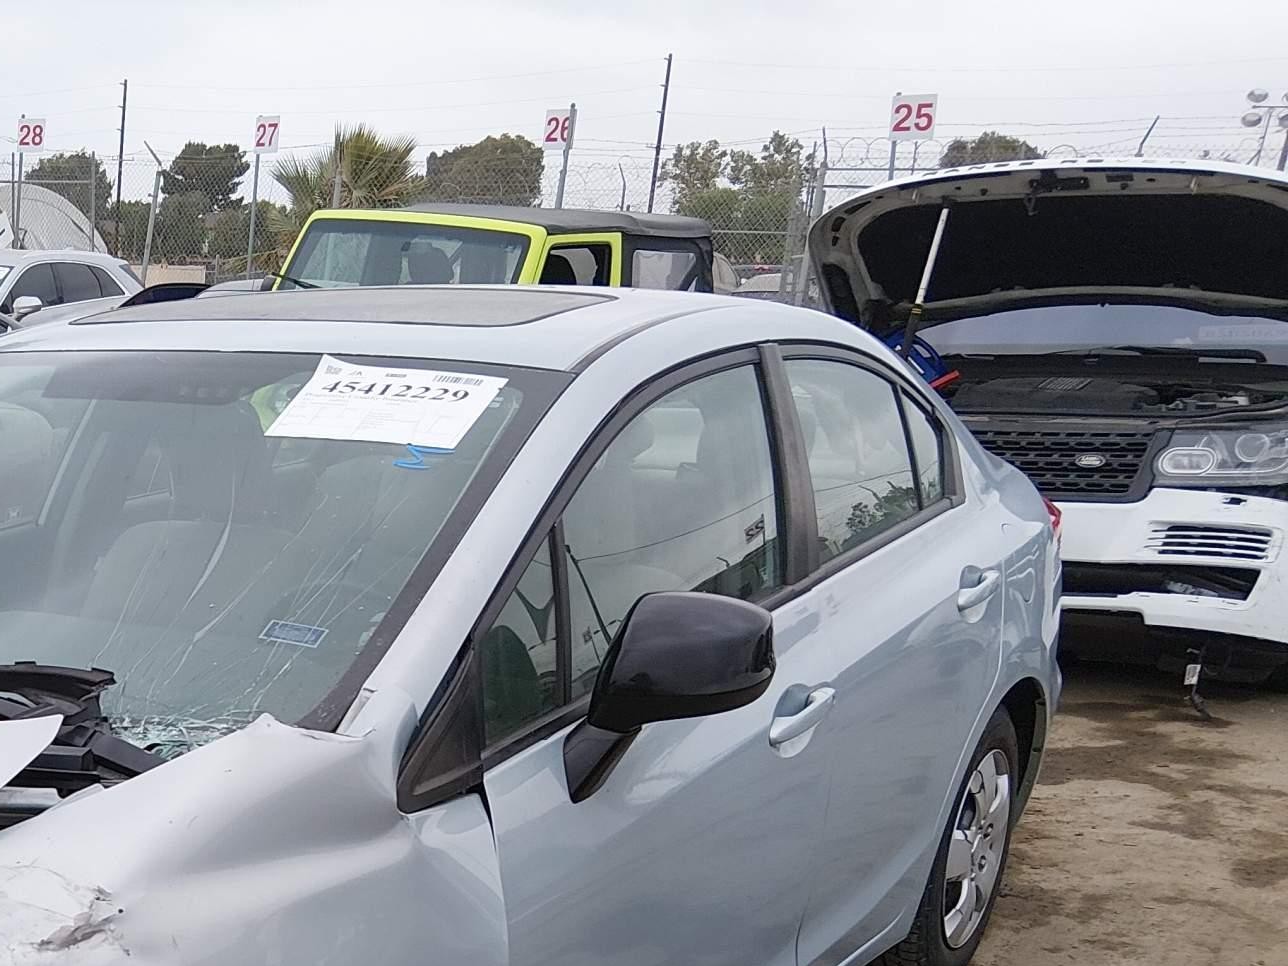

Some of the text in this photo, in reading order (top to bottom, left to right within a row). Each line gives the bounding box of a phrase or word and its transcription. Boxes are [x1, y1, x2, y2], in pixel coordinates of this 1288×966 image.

[545, 116, 569, 142] 26
[892, 103, 933, 131] 25
[19, 124, 43, 146] 28
[256, 123, 278, 147] 27
[321, 380, 470, 403] 45412229
